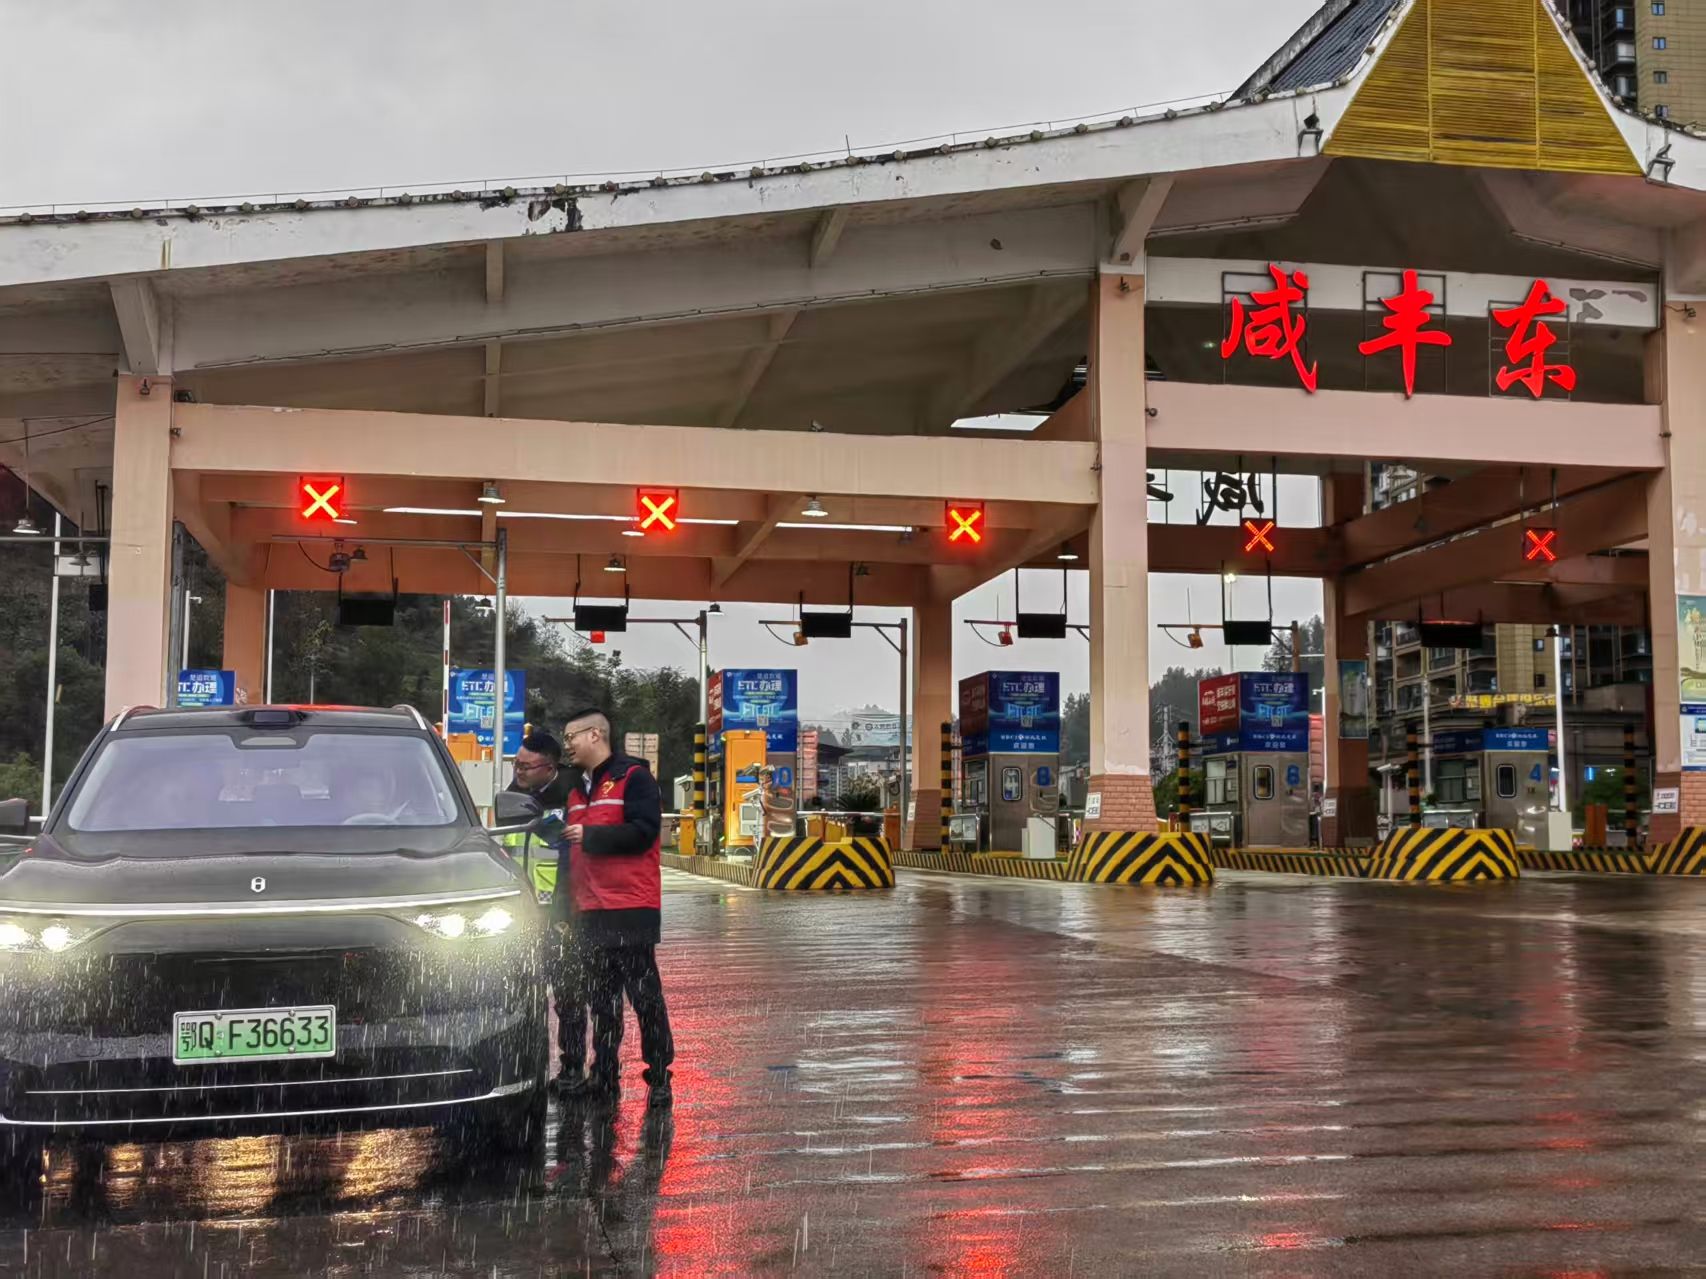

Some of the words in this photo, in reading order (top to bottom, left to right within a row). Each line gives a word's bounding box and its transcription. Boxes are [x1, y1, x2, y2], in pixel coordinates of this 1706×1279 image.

[1220, 261, 1577, 400] 咸丰东
[178, 682, 191, 692] TC
[462, 680, 483, 691] ETC
[737, 680, 758, 690] ETC
[759, 680, 782, 691] 办理
[1003, 682, 1022, 692] ETC
[1529, 763, 1542, 782] 4
[228, 1015, 329, 1050] F36633
